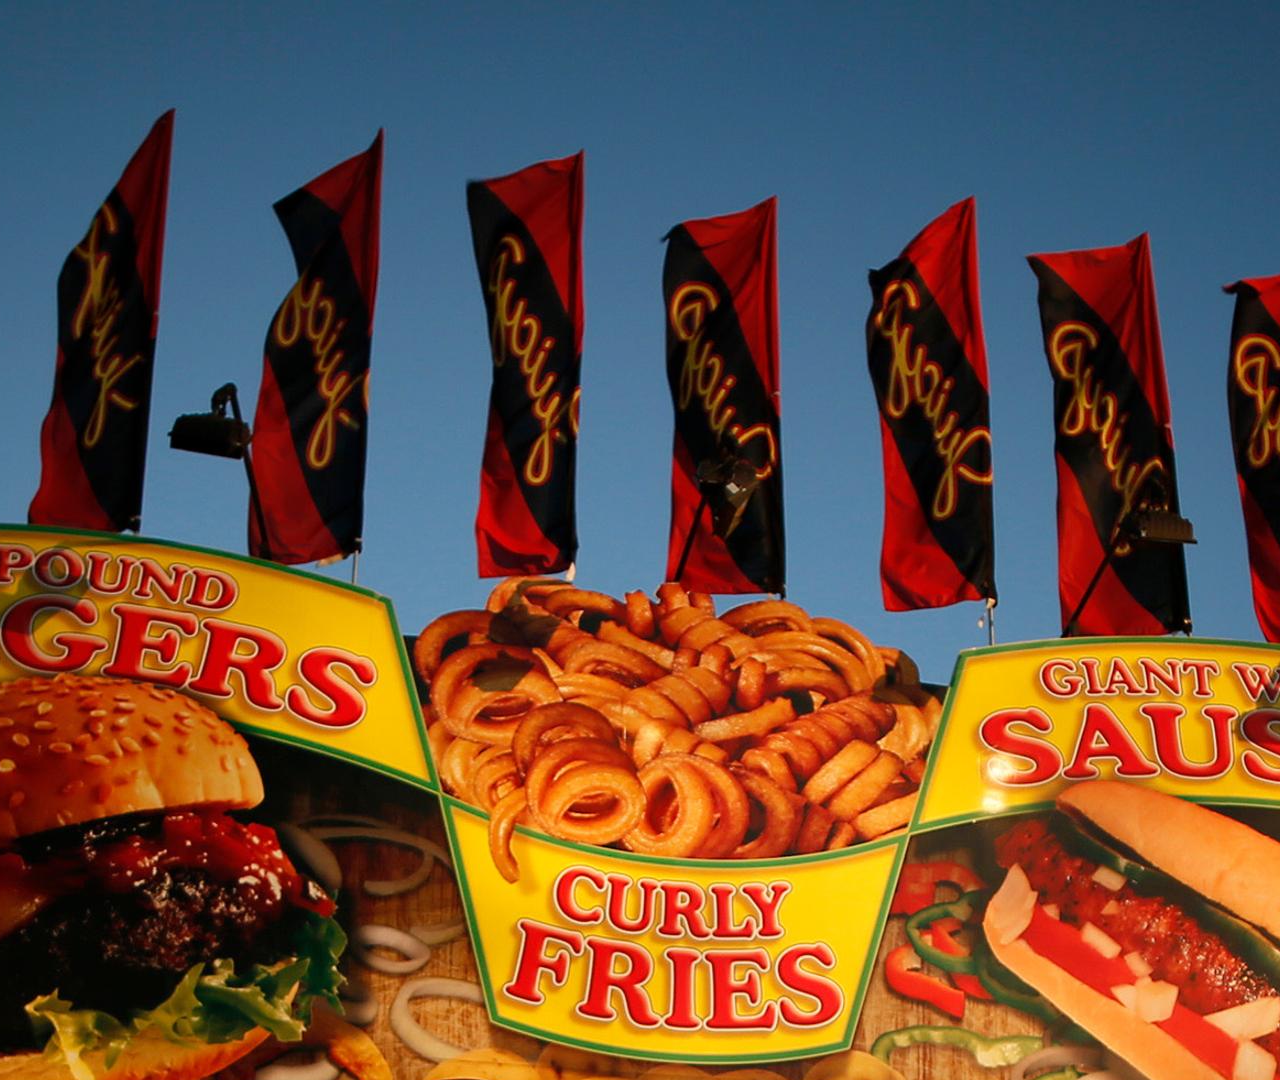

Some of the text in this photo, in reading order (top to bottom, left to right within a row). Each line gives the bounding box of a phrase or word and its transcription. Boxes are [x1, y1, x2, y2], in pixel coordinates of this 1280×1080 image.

[1040, 658, 1218, 699] GIANT
[553, 865, 792, 942] CURLY
[504, 919, 844, 1033] FRIES
